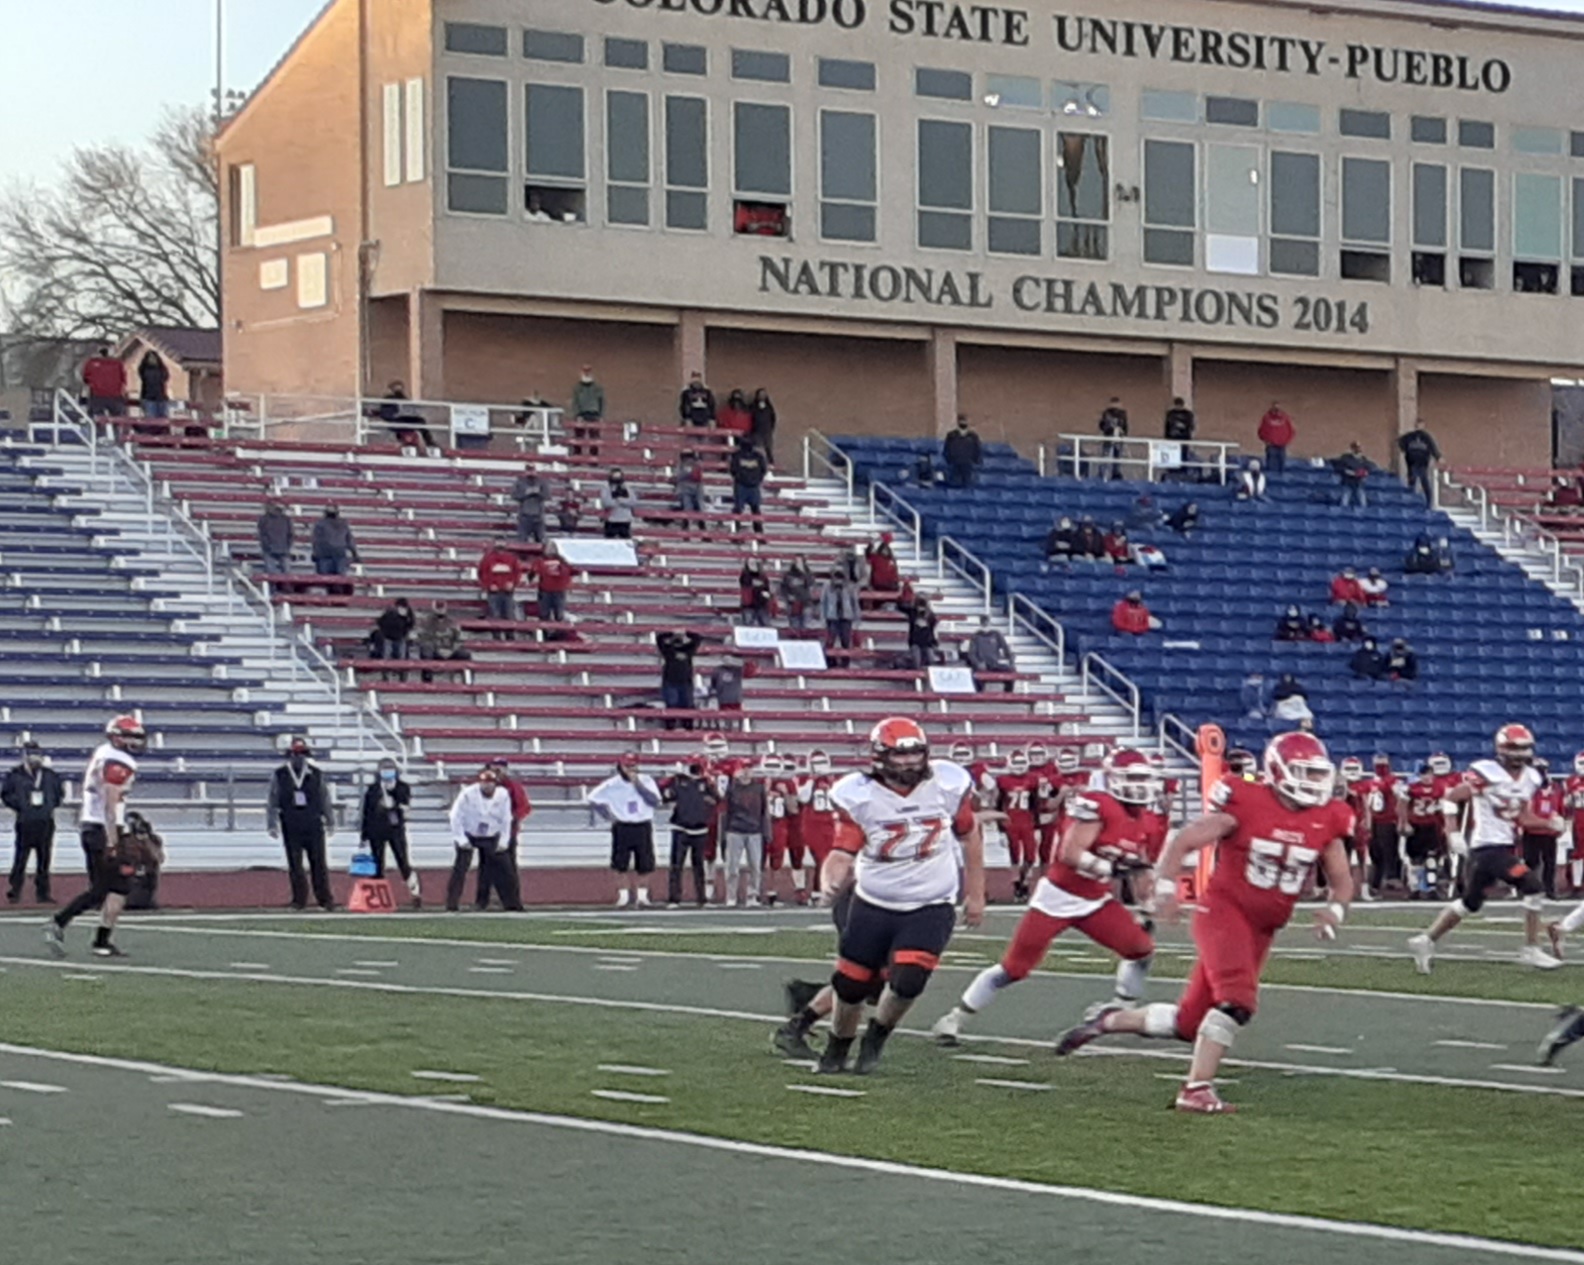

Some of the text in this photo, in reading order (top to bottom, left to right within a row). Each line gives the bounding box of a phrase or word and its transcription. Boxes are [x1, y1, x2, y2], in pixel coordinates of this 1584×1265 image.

[592, 0, 1511, 94] RADO STATE UNIVERSITY-PUEBLO
[758, 255, 1369, 334] NATIONAL CHAMPIONS 2014
[873, 815, 949, 862] 77
[1246, 836, 1320, 895] 55
[361, 884, 394, 909] 20
